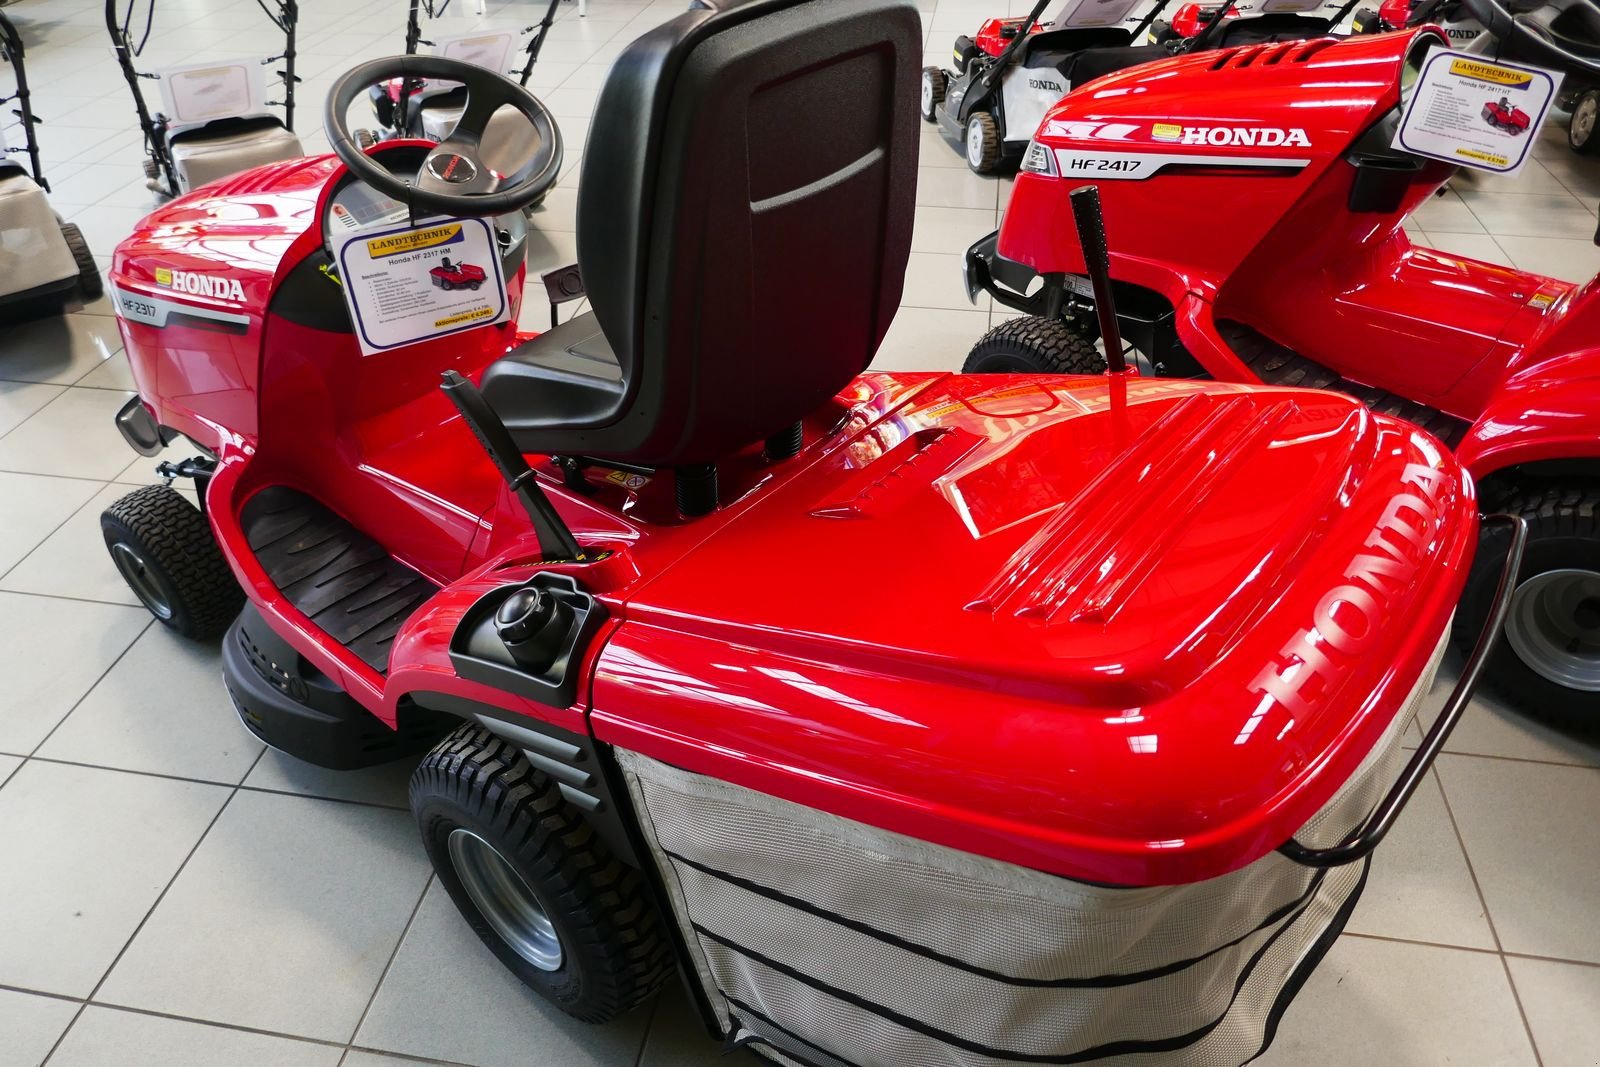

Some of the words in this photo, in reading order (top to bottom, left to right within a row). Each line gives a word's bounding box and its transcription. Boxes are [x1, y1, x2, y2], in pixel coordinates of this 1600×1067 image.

[1444, 28, 1481, 39] ONDA
[1455, 61, 1523, 82] LANDTECHNIK
[1181, 127, 1312, 147] HONDA
[1071, 158, 1096, 170] HF
[1097, 159, 1142, 172] 2417
[370, 227, 452, 250] LANDTECHNIK
[388, 255, 411, 266] Honda
[411, 253, 422, 262] HF
[423, 250, 439, 260] 2317
[440, 247, 452, 256] HM
[172, 270, 248, 302] HONDA
[122, 298, 134, 311] HF
[134, 302, 157, 317] 2317
[1246, 462, 1449, 718] HONDA
